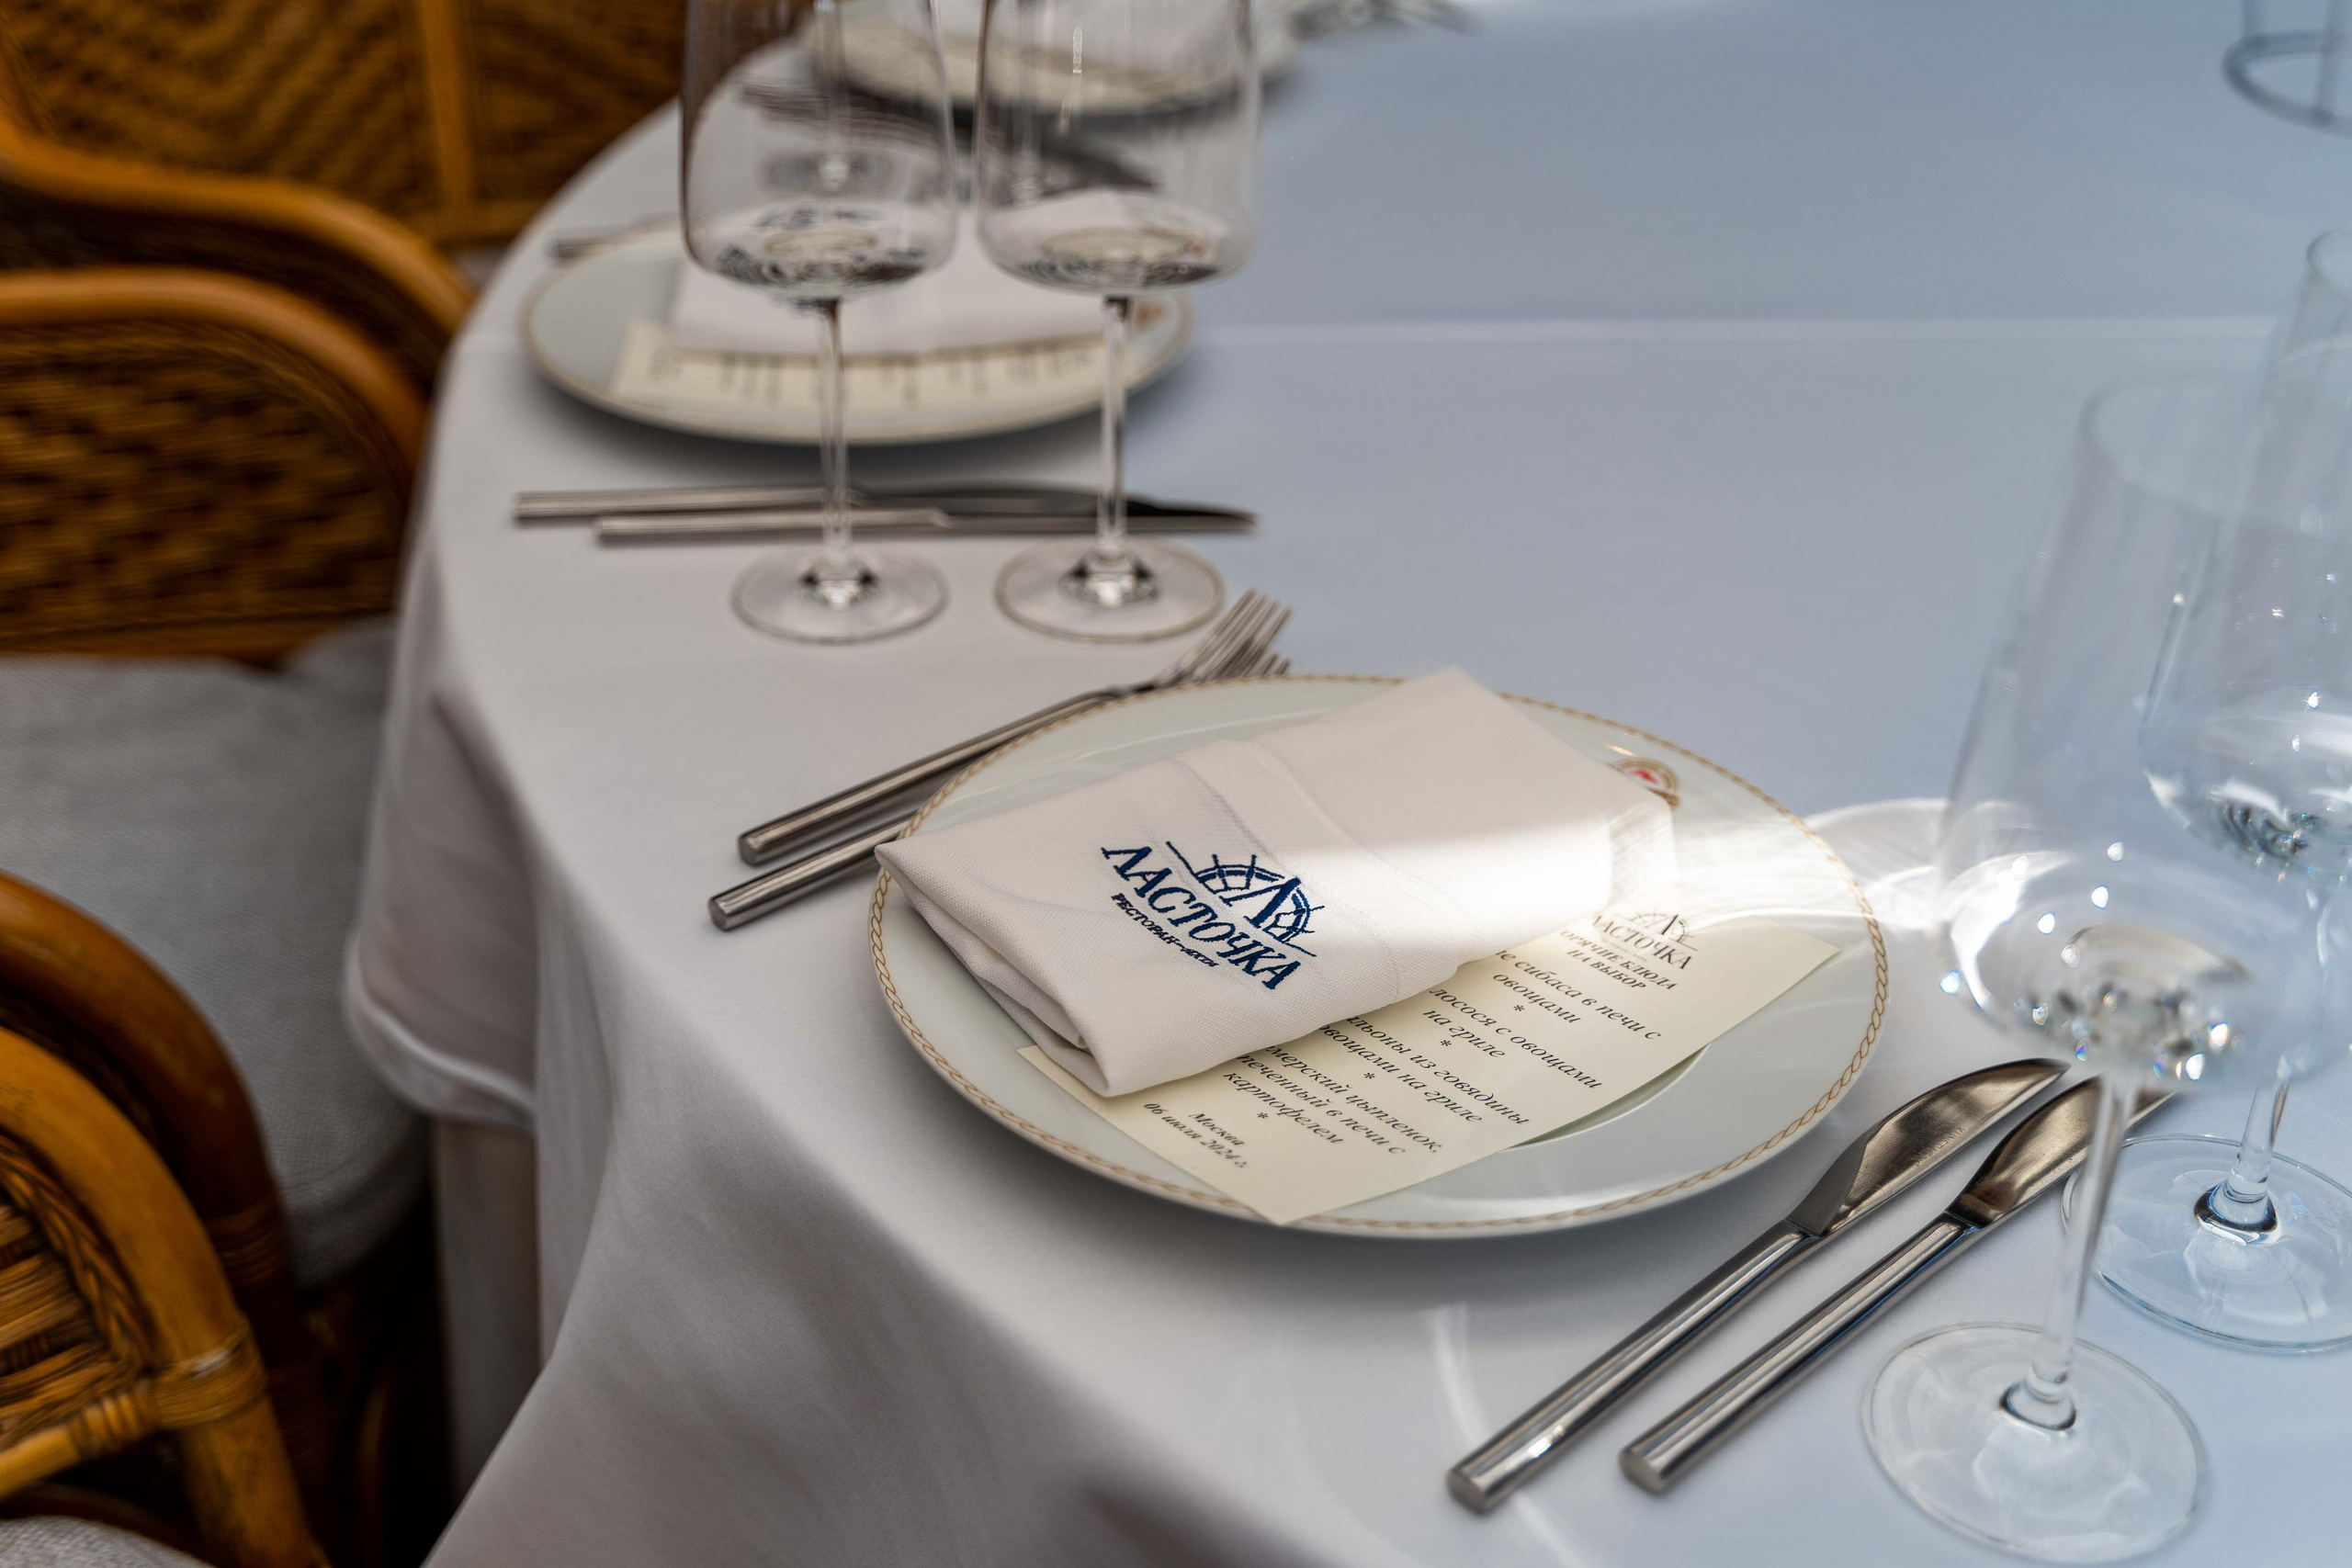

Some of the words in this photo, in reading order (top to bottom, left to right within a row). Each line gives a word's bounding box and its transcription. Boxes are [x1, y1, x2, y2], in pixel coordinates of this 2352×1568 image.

[1101, 846, 1301, 989] ЛАСТОЧКА
[1560, 930, 1623, 963] ОРЯЧИЕ
[1620, 960, 1678, 990] БЛЮДА
[1566, 949, 1591, 963] НА
[1589, 961, 1647, 989] ВЫБОР
[1493, 974, 1581, 1024] овощами
[1514, 961, 1583, 998] сибаса
[1581, 998, 1598, 1006] в
[1596, 1005, 1646, 1032] печи
[1645, 1031, 1661, 1041] с
[1422, 1010, 1452, 1026] на
[1449, 1025, 1506, 1058] гриле
[1429, 988, 1497, 1027] лосося
[1496, 1027, 1511, 1035] с
[1510, 1035, 1603, 1089] овощами
[1223, 1072, 1344, 1145] картофелем
[1397, 1073, 1427, 1089] на
[1424, 1090, 1483, 1122] гриле
[1410, 1055, 1436, 1070] из
[1433, 1069, 1529, 1125] говядины
[1144, 1103, 1169, 1115] 06
[1161, 1115, 1202, 1139] июля
[1200, 1139, 1240, 1159] 2024
[1188, 1112, 1245, 1146] Москва
[1326, 1109, 1342, 1117] в
[1340, 1116, 1390, 1146] печи
[1388, 1146, 1406, 1155] с
[1346, 1093, 1442, 1153] цыпленок,
